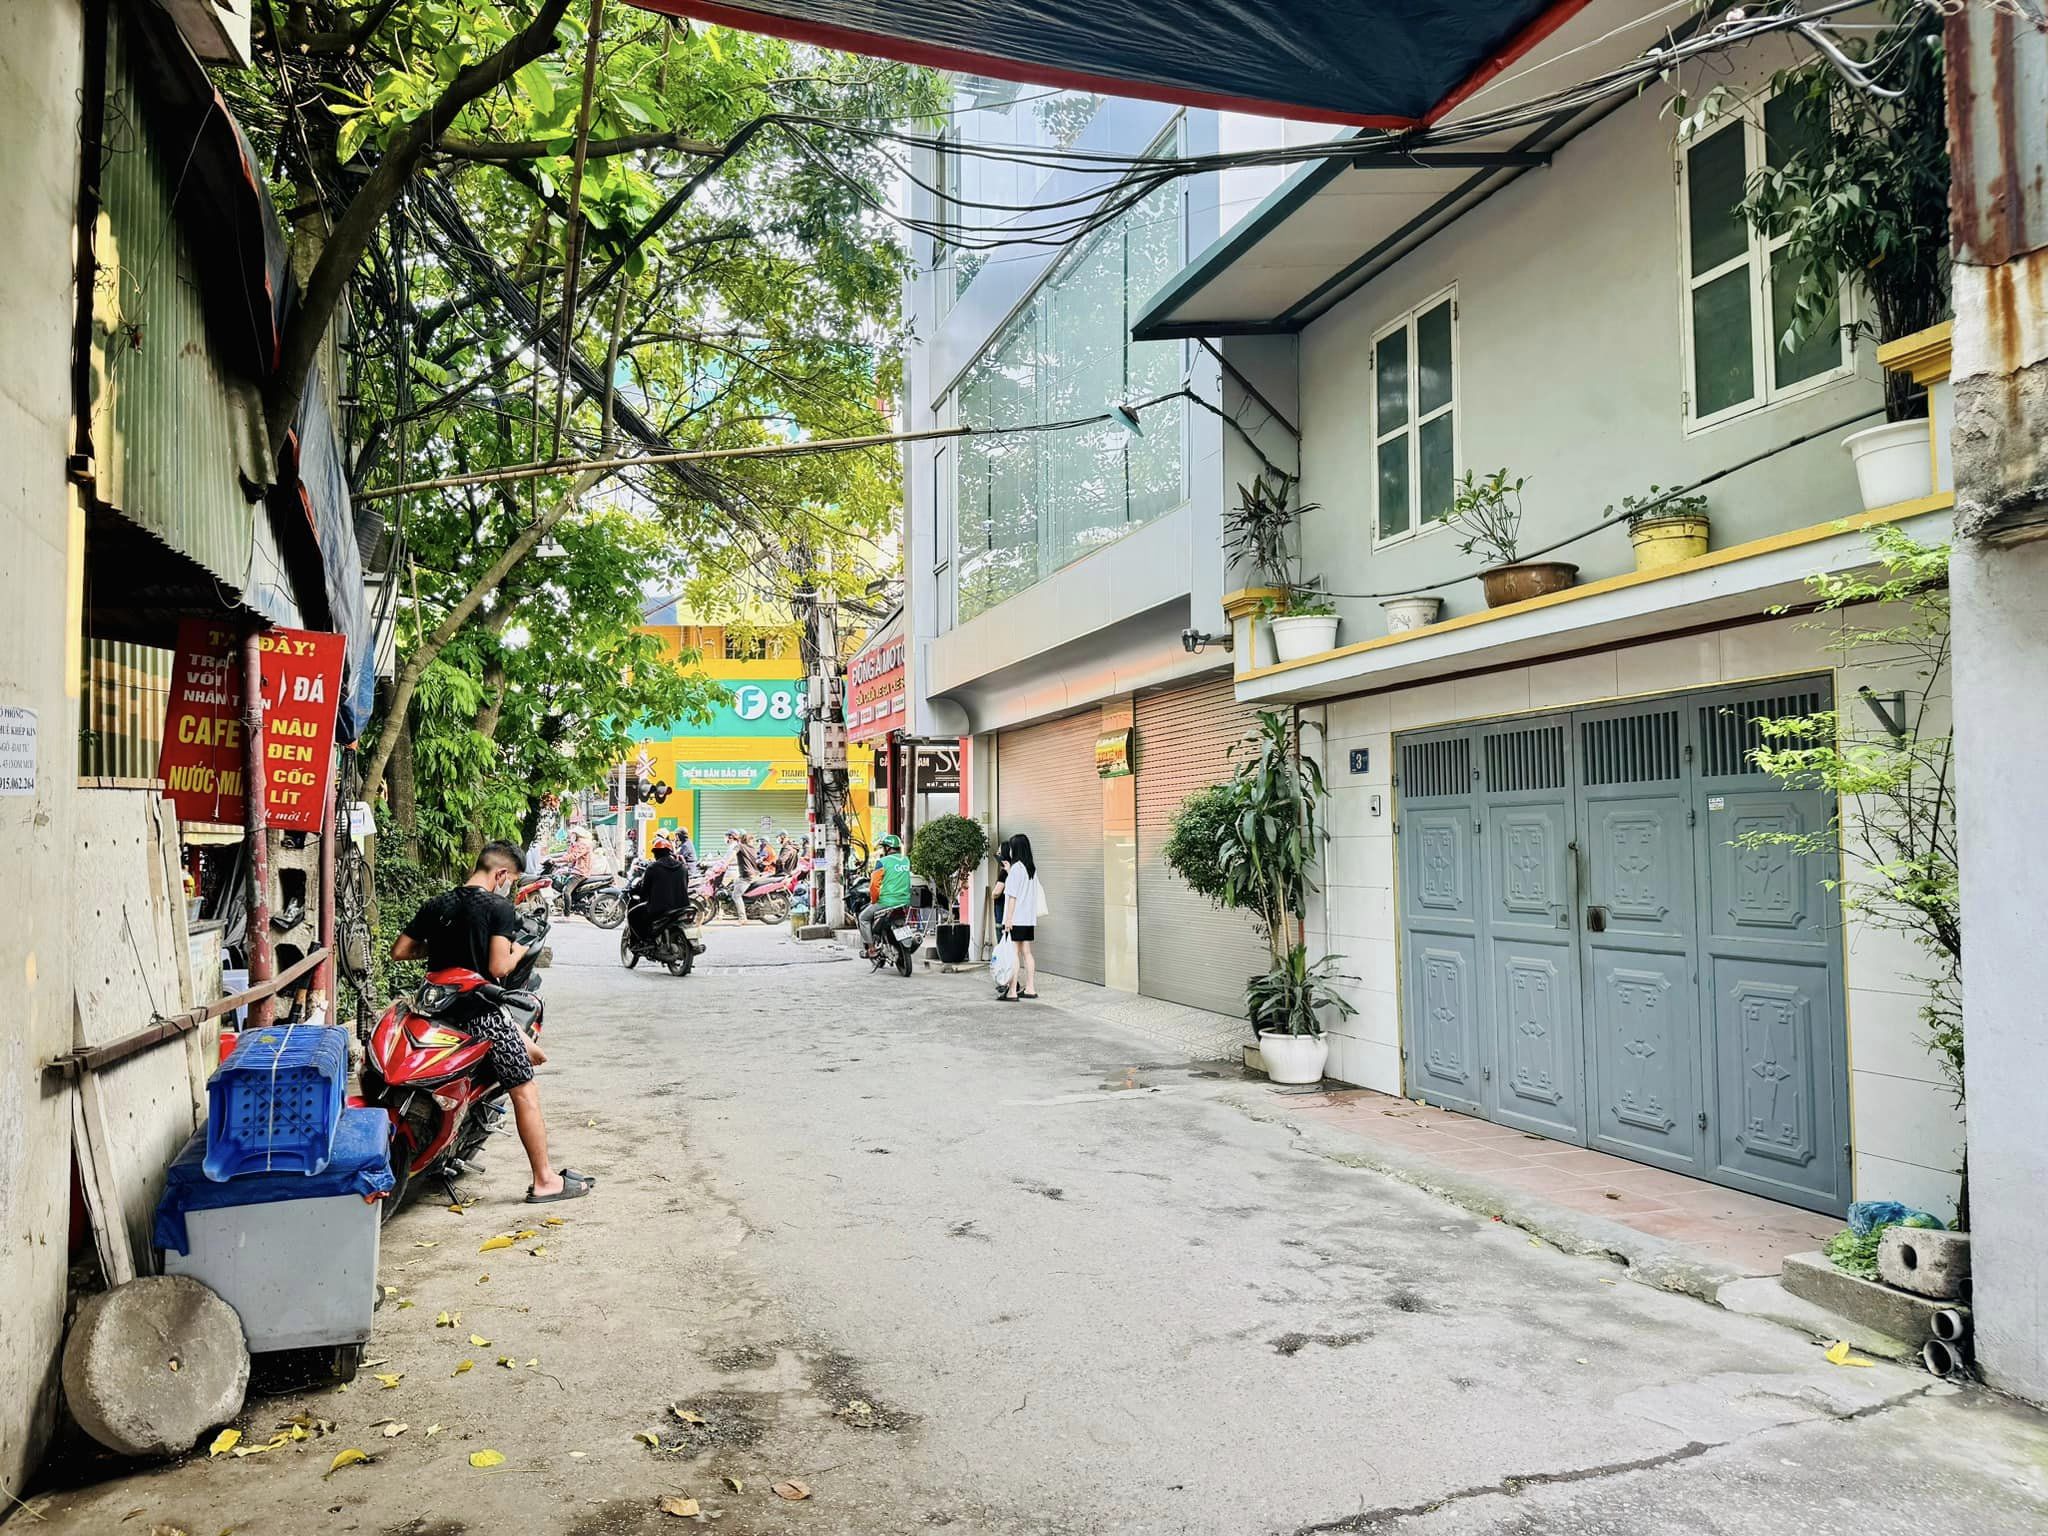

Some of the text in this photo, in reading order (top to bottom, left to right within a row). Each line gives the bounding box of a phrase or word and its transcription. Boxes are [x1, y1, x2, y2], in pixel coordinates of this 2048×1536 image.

[259, 635, 316, 657] ĐÂY!
[183, 688, 228, 706] NHÂN
[293, 673, 325, 704] ĐÁ
[178, 714, 240, 748] CAFE
[271, 718, 318, 738] NÂU
[267, 743, 313, 762] ĐEN
[168, 761, 214, 794] NƯỚC
[273, 768, 316, 786] CỐC
[270, 789, 301, 805] LÍT
